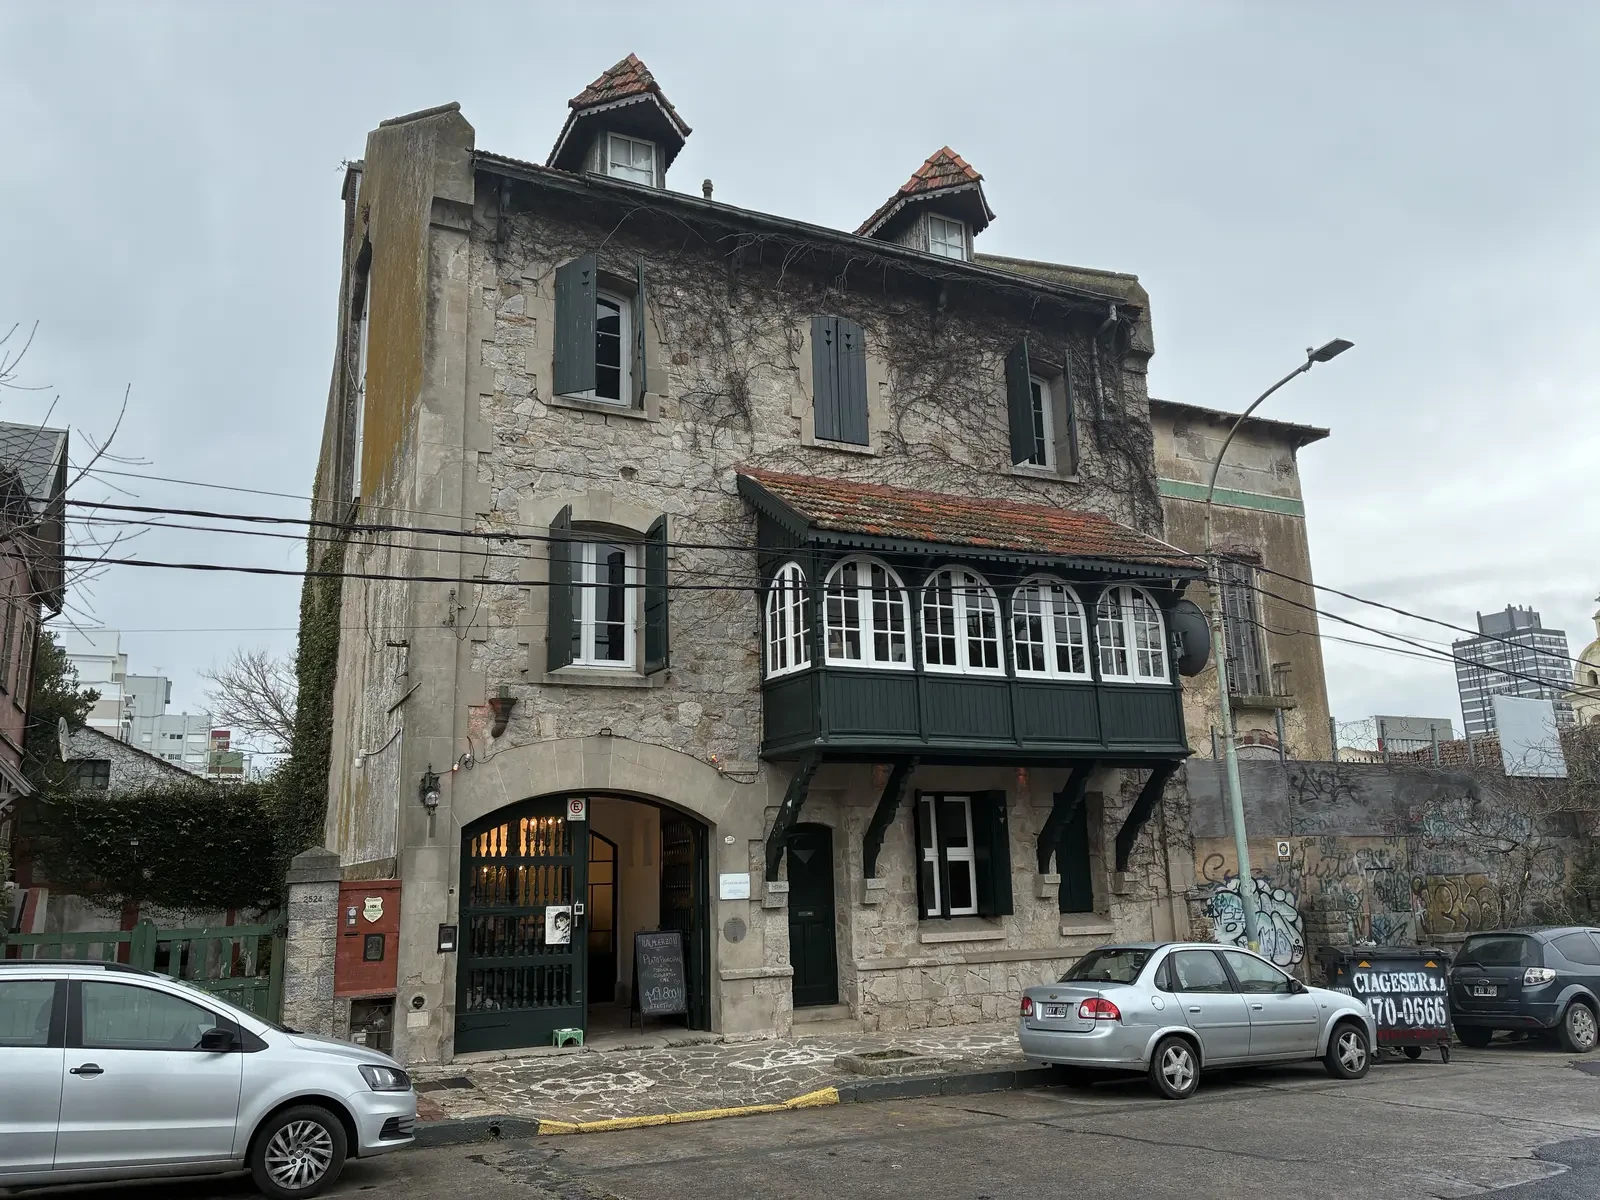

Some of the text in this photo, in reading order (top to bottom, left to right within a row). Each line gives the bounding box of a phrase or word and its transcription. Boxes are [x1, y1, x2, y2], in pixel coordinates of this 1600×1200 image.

[573, 802, 580, 811] E
[303, 895, 323, 903] 2524
[1353, 972, 1429, 993] CIAGESER
